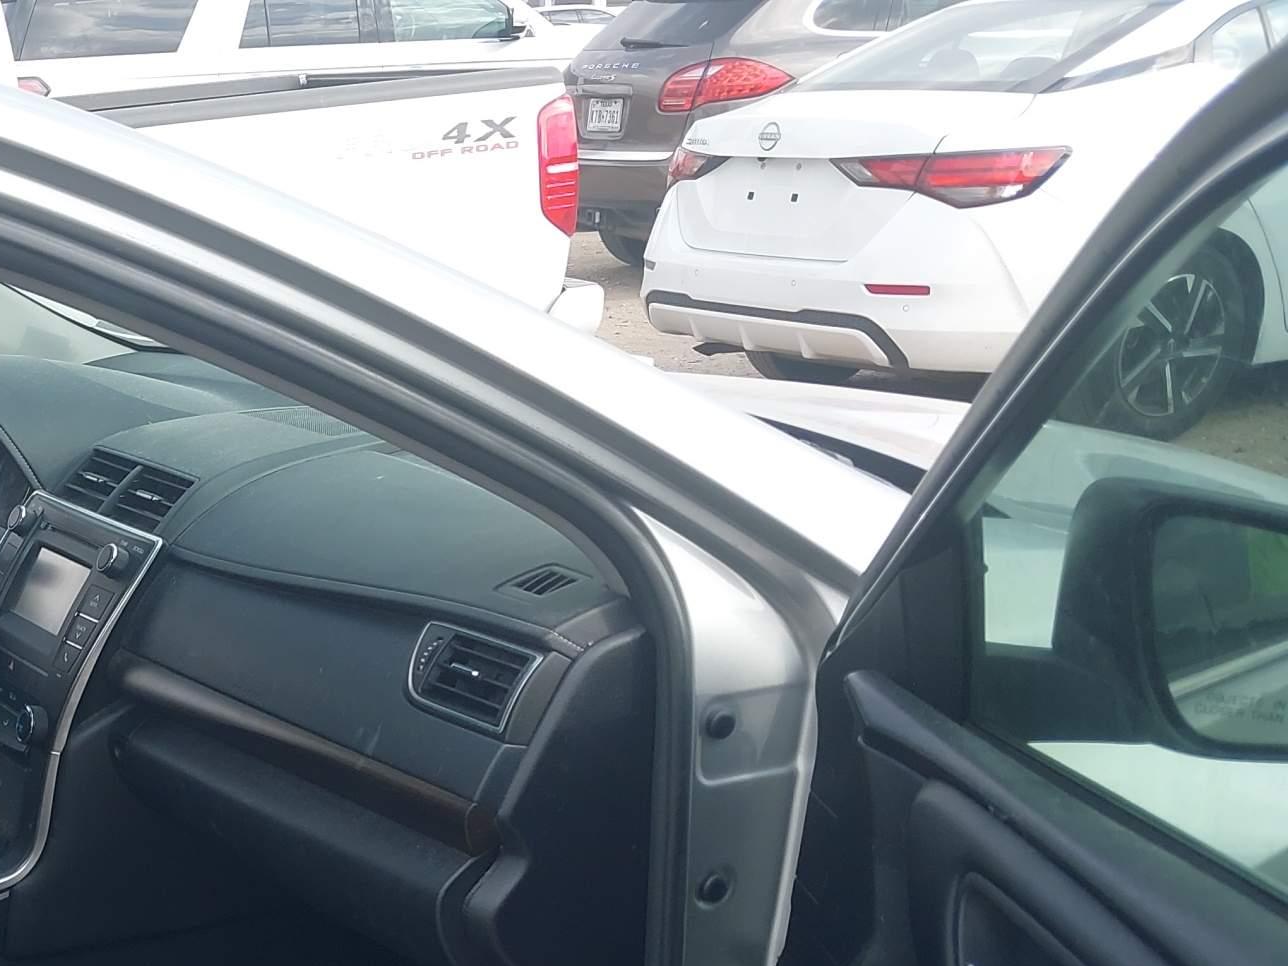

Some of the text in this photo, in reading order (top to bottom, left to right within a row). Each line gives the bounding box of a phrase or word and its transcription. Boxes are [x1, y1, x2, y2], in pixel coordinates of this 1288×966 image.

[582, 62, 640, 70] PORSCHE
[412, 140, 519, 160] OFF ROAD
